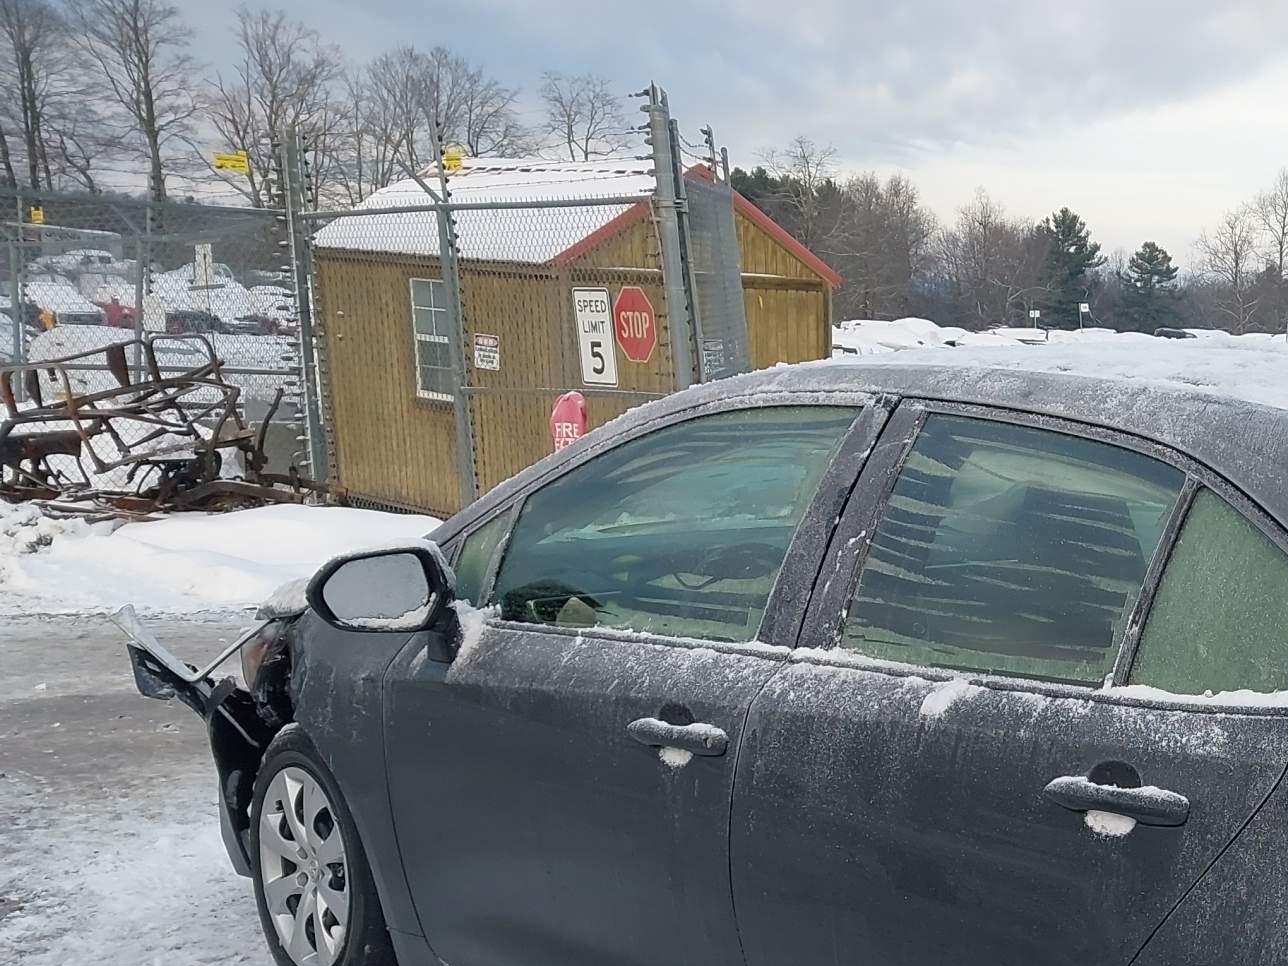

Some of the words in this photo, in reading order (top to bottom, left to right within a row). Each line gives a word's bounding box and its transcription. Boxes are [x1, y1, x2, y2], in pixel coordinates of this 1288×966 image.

[577, 300, 606, 313] SPEED
[583, 321, 606, 334] LIMIT
[620, 311, 649, 338] STOP
[590, 341, 605, 375] 5
[554, 422, 579, 438] FIRE
